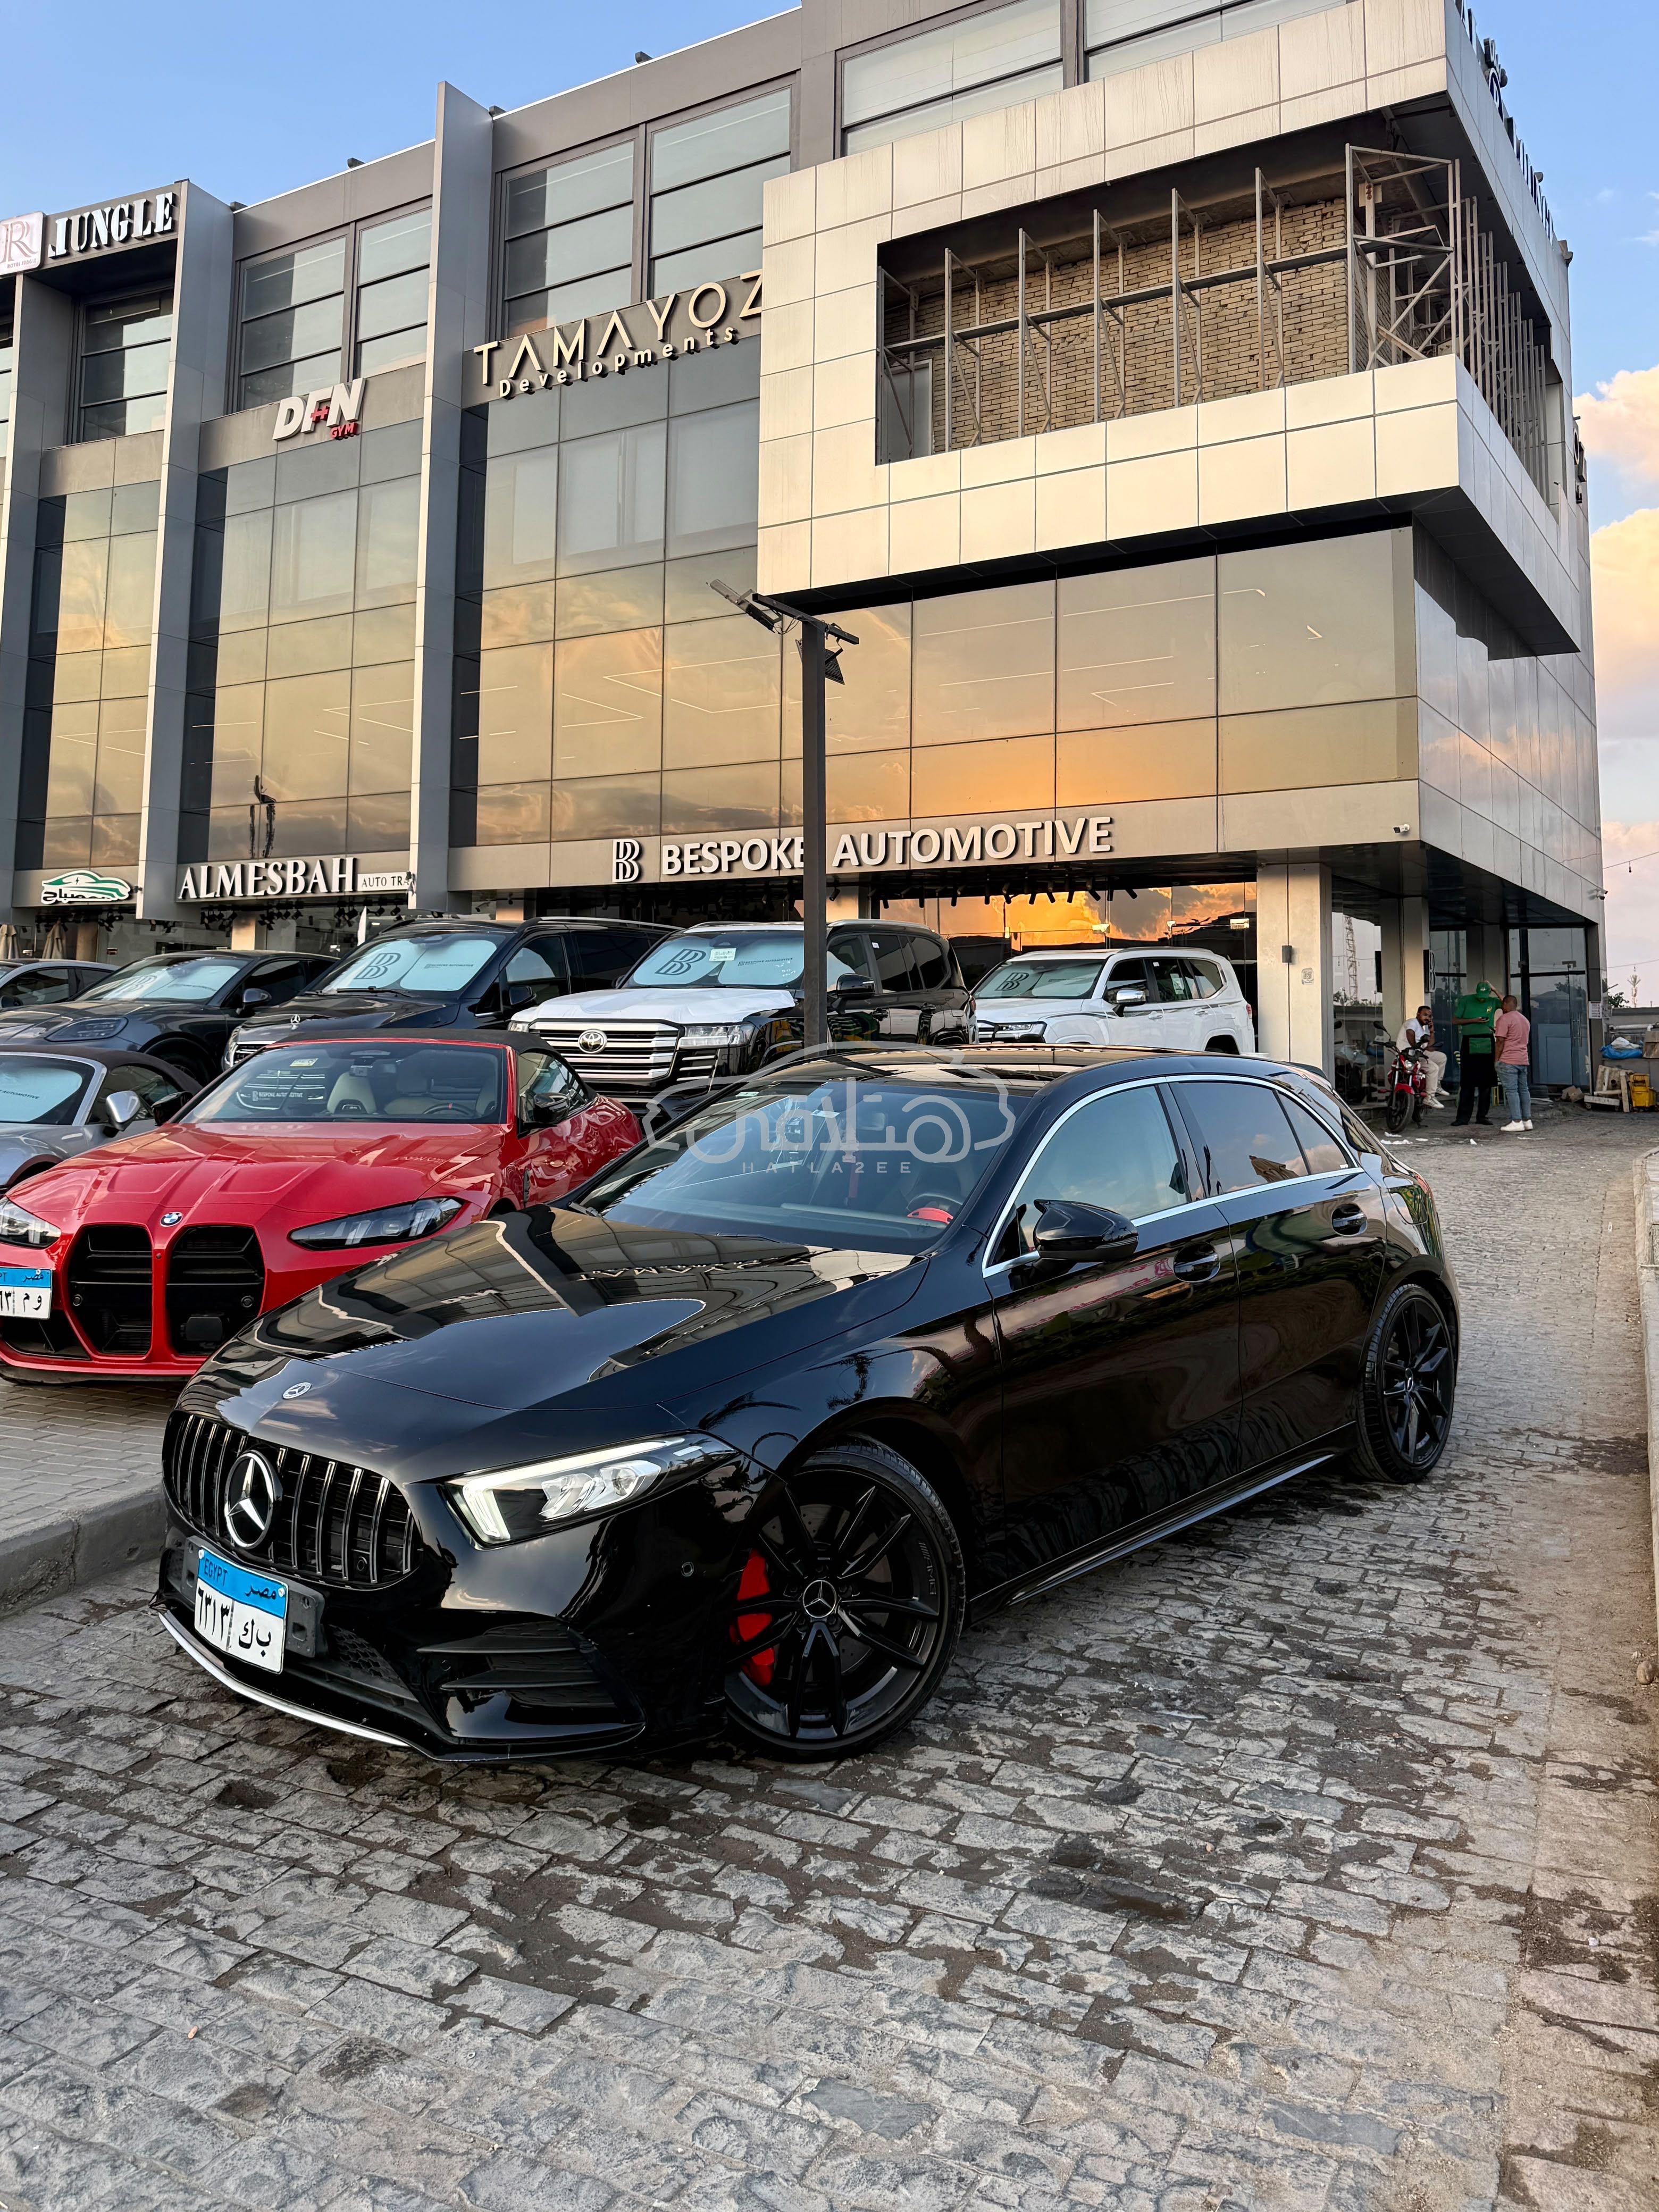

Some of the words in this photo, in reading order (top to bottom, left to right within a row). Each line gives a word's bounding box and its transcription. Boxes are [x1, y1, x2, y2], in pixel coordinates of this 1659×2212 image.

[48, 191, 174, 258] JUNGLE
[473, 269, 763, 386] TAMAYOZ
[499, 324, 738, 399] Developments
[330, 423, 358, 440] GYM
[662, 836, 804, 876] BESPOKE
[832, 816, 1114, 868] AUTOMOTIVE
[178, 857, 356, 900] ALMESBAH
[362, 876, 387, 887] AUTO
[2, 1090, 40, 1100] AUTOMOTIVE
[204, 1557, 228, 1587] EGYPT
[245, 1585, 277, 1600] مصر
